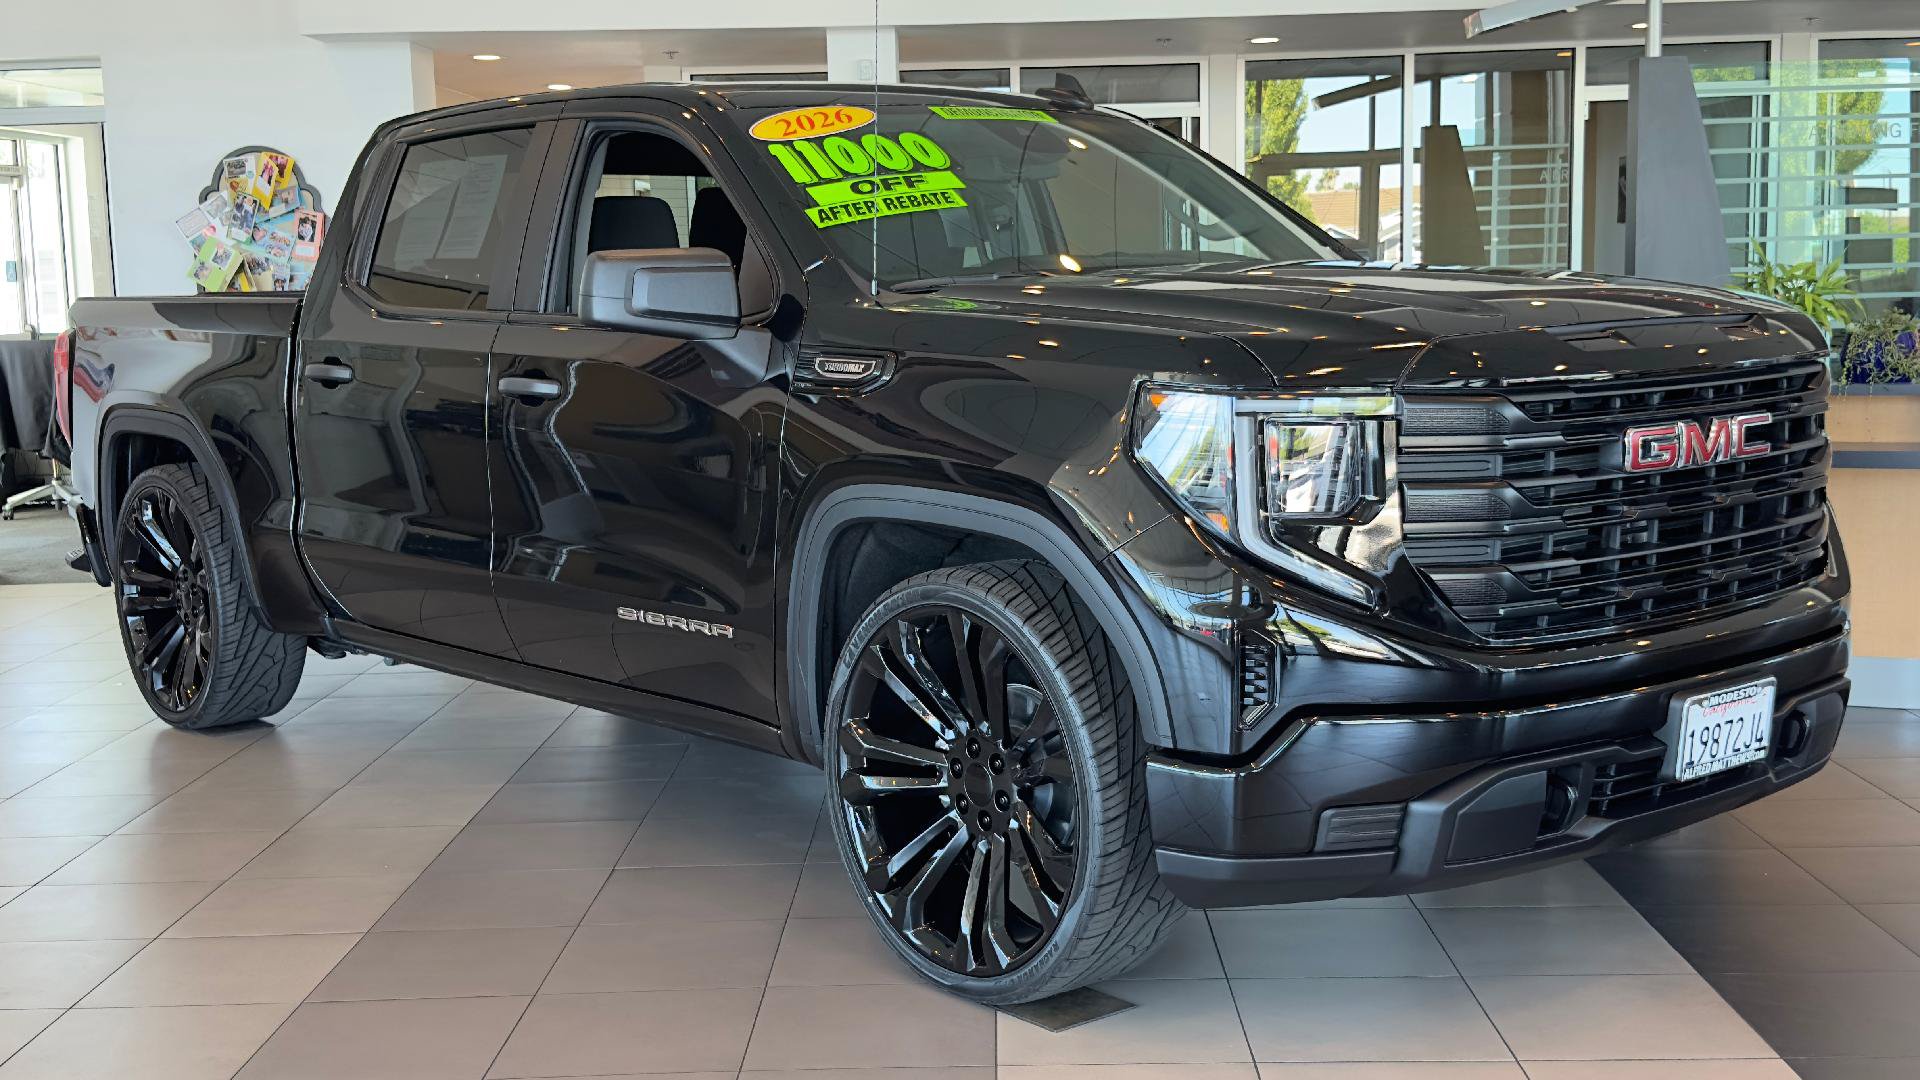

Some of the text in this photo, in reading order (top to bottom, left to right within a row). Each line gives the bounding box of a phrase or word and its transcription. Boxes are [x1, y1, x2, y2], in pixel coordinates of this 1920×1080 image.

[775, 107, 853, 138] 2026
[768, 131, 950, 184] 11000
[849, 174, 926, 196] OFF
[817, 190, 956, 225] AFTER REBATE
[1625, 412, 1773, 472] GMC
[616, 606, 734, 639] SIERRA
[1709, 687, 1757, 706] MODESTO
[1685, 711, 1764, 768] 19872J4
